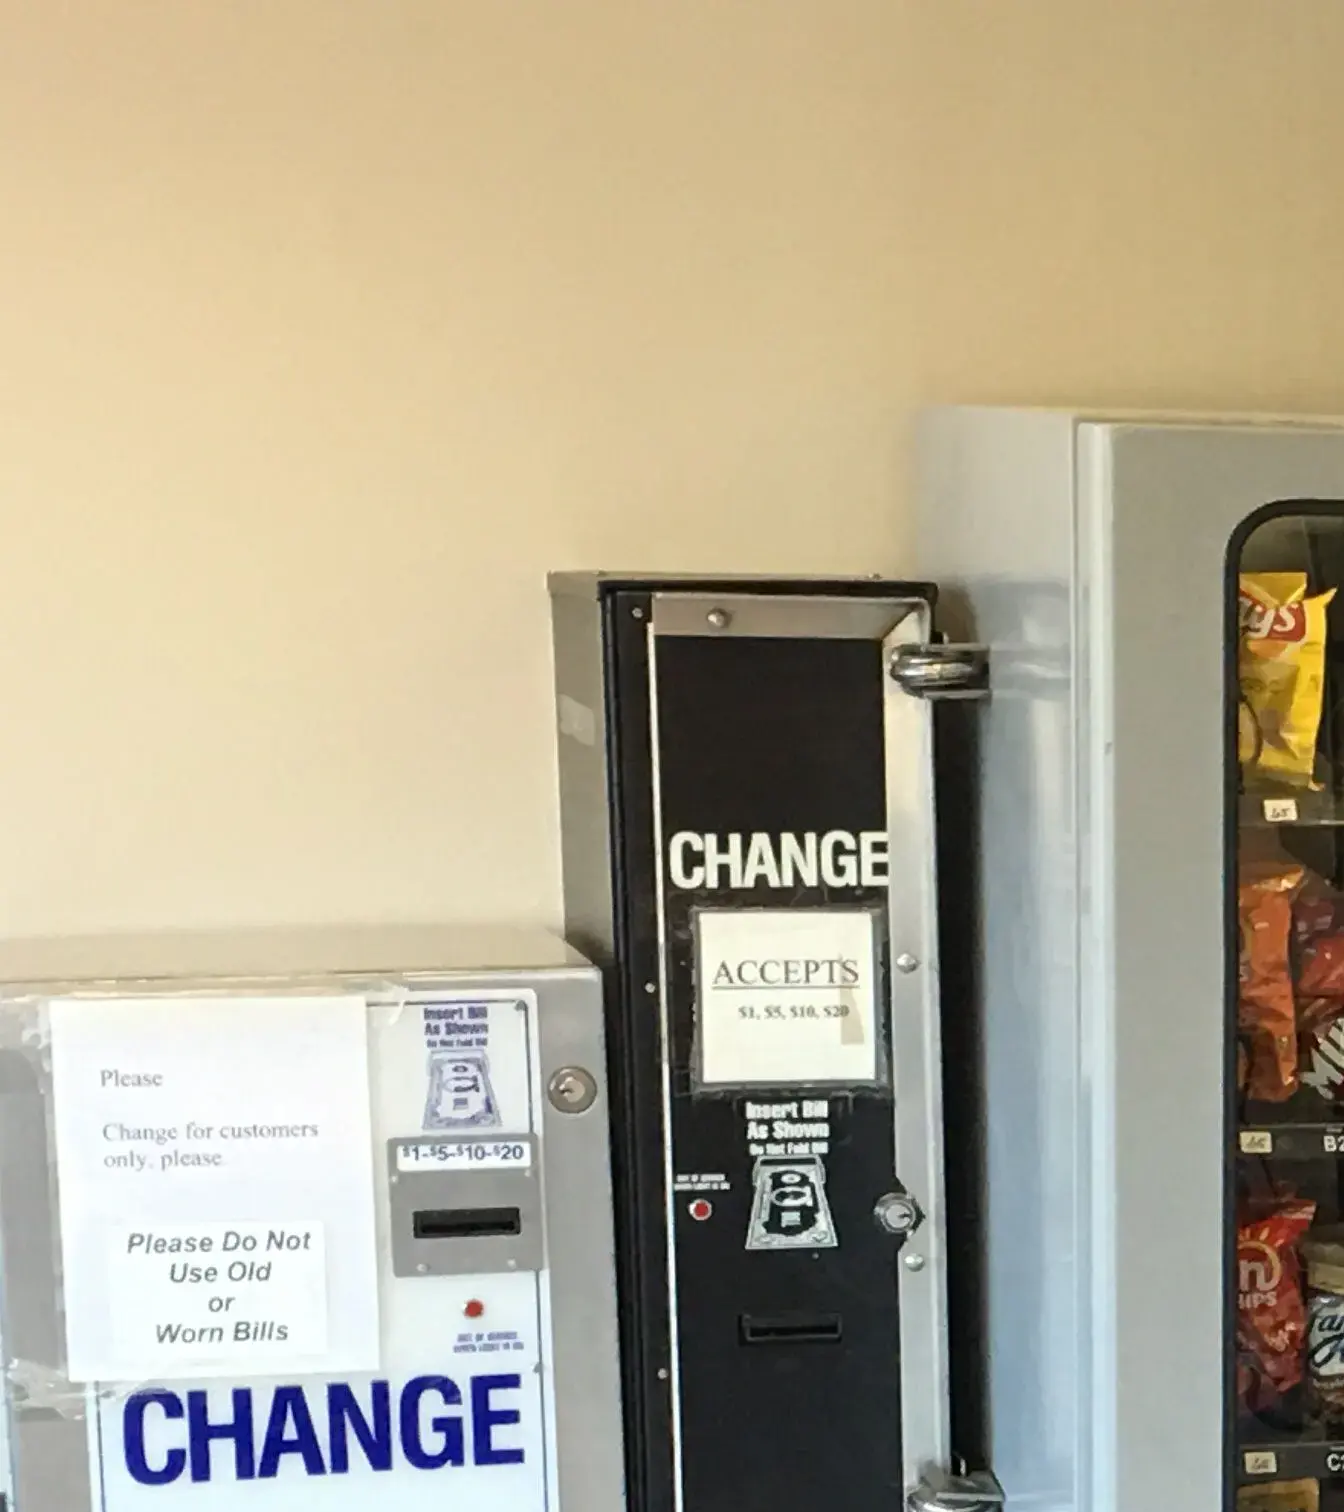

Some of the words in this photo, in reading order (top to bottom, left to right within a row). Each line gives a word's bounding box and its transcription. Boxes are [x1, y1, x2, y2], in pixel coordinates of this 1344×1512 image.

[669, 830, 889, 889] CHANGE
[712, 958, 860, 986] ACCEPTS
[424, 1007, 463, 1020] Insert
[424, 1023, 440, 1035] As
[445, 1022, 489, 1035] Shown
[101, 1069, 163, 1088] Please
[103, 1121, 178, 1145] Change
[186, 1121, 213, 1140] for
[220, 1121, 319, 1139] customers
[747, 1121, 769, 1139] As
[772, 1121, 830, 1138] Shown
[103, 1150, 155, 1170] only,
[127, 1233, 213, 1254] Please
[222, 1232, 258, 1252] Do
[266, 1231, 312, 1251] Not
[169, 1263, 219, 1284] Use
[227, 1261, 272, 1282] Old
[208, 1296, 235, 1313] or
[155, 1322, 224, 1345] Worn
[233, 1321, 290, 1343] Bills
[122, 1373, 526, 1486] CHANGE
